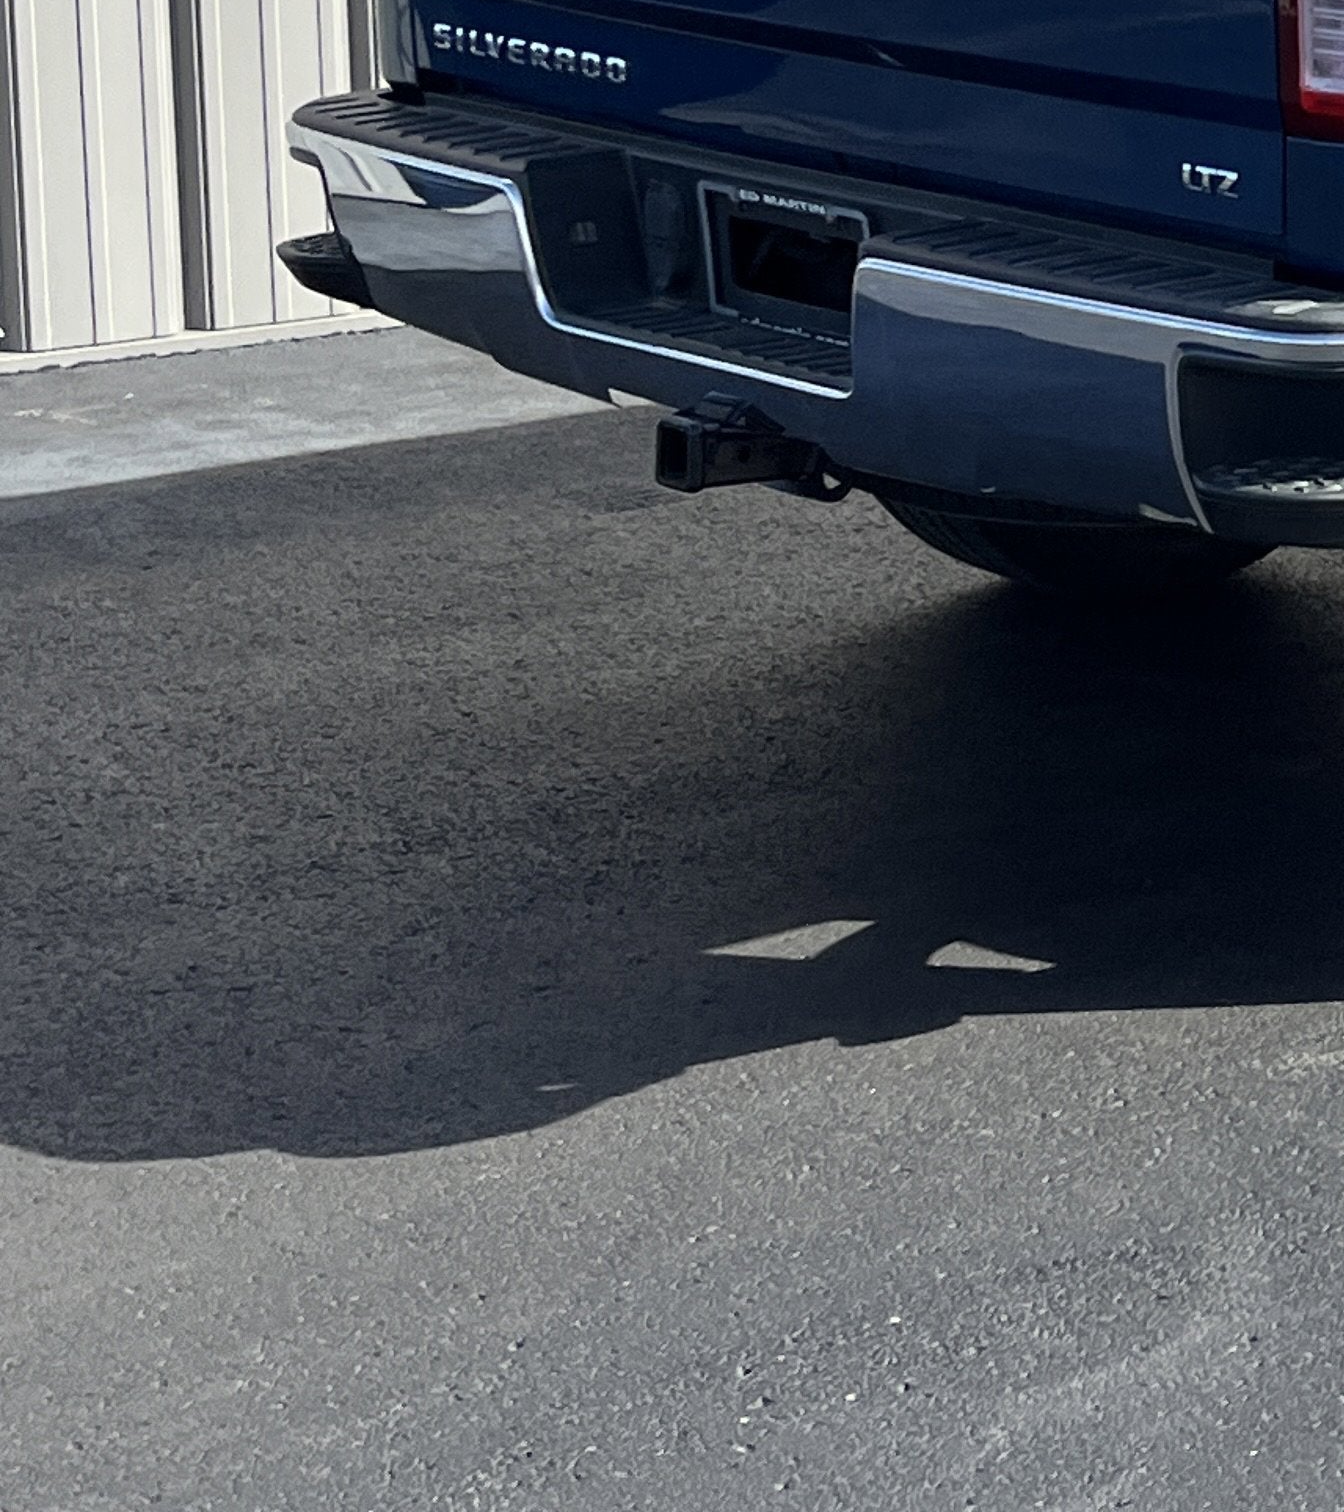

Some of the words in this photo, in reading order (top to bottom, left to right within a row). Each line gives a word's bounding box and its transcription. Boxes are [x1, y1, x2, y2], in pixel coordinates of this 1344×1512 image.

[433, 23, 627, 83] SILVERADO
[1182, 163, 1239, 198] LTZ
[763, 193, 826, 215] MARTIN
